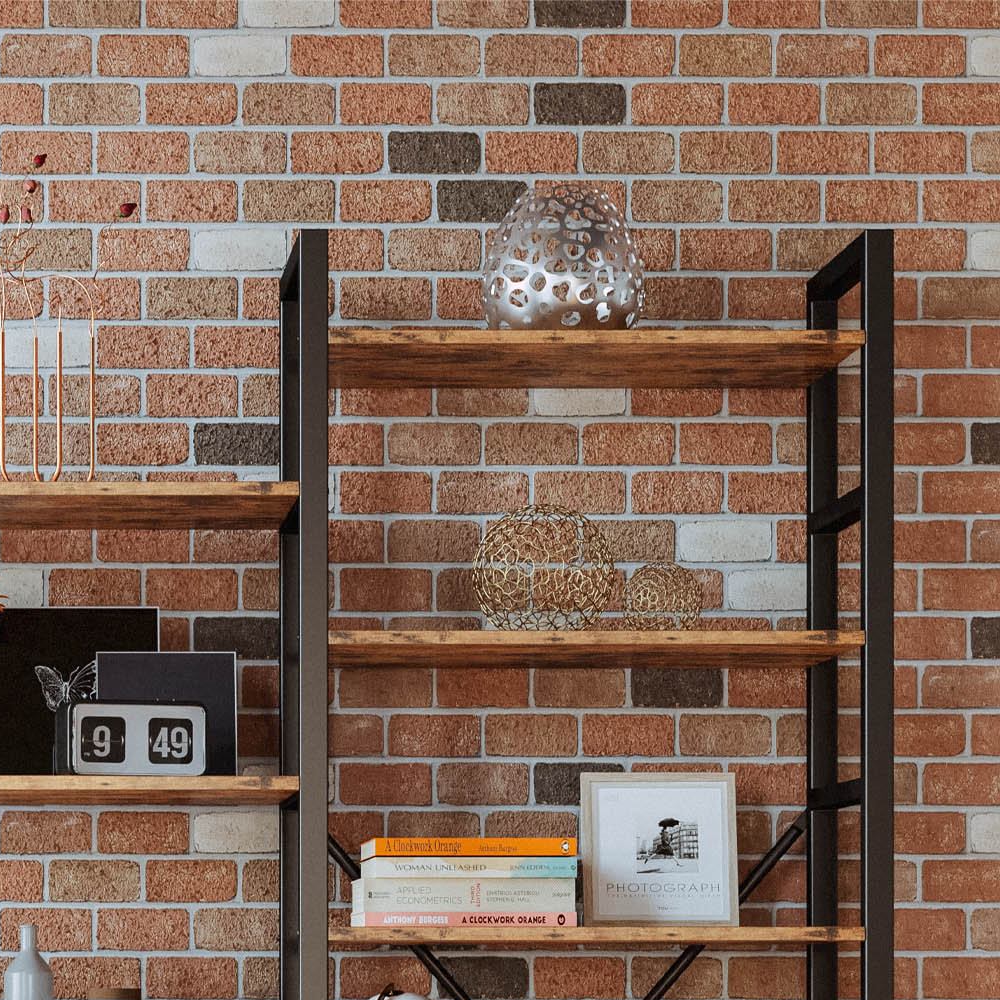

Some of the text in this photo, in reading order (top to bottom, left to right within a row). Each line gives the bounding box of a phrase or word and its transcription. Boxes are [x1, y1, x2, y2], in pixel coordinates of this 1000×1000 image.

[93, 725, 189, 758] 9 49
[384, 839, 462, 854] A Clockwork Orange
[396, 887, 432, 895] APPLIED
[606, 883, 720, 893] PHOTOGRAPH
[396, 897, 463, 905] ECONOMETRICS
[384, 915, 448, 924] ANTHONY BURGESS
[469, 916, 515, 924] CLOCKWORK
[518, 916, 546, 924] ORANGE
